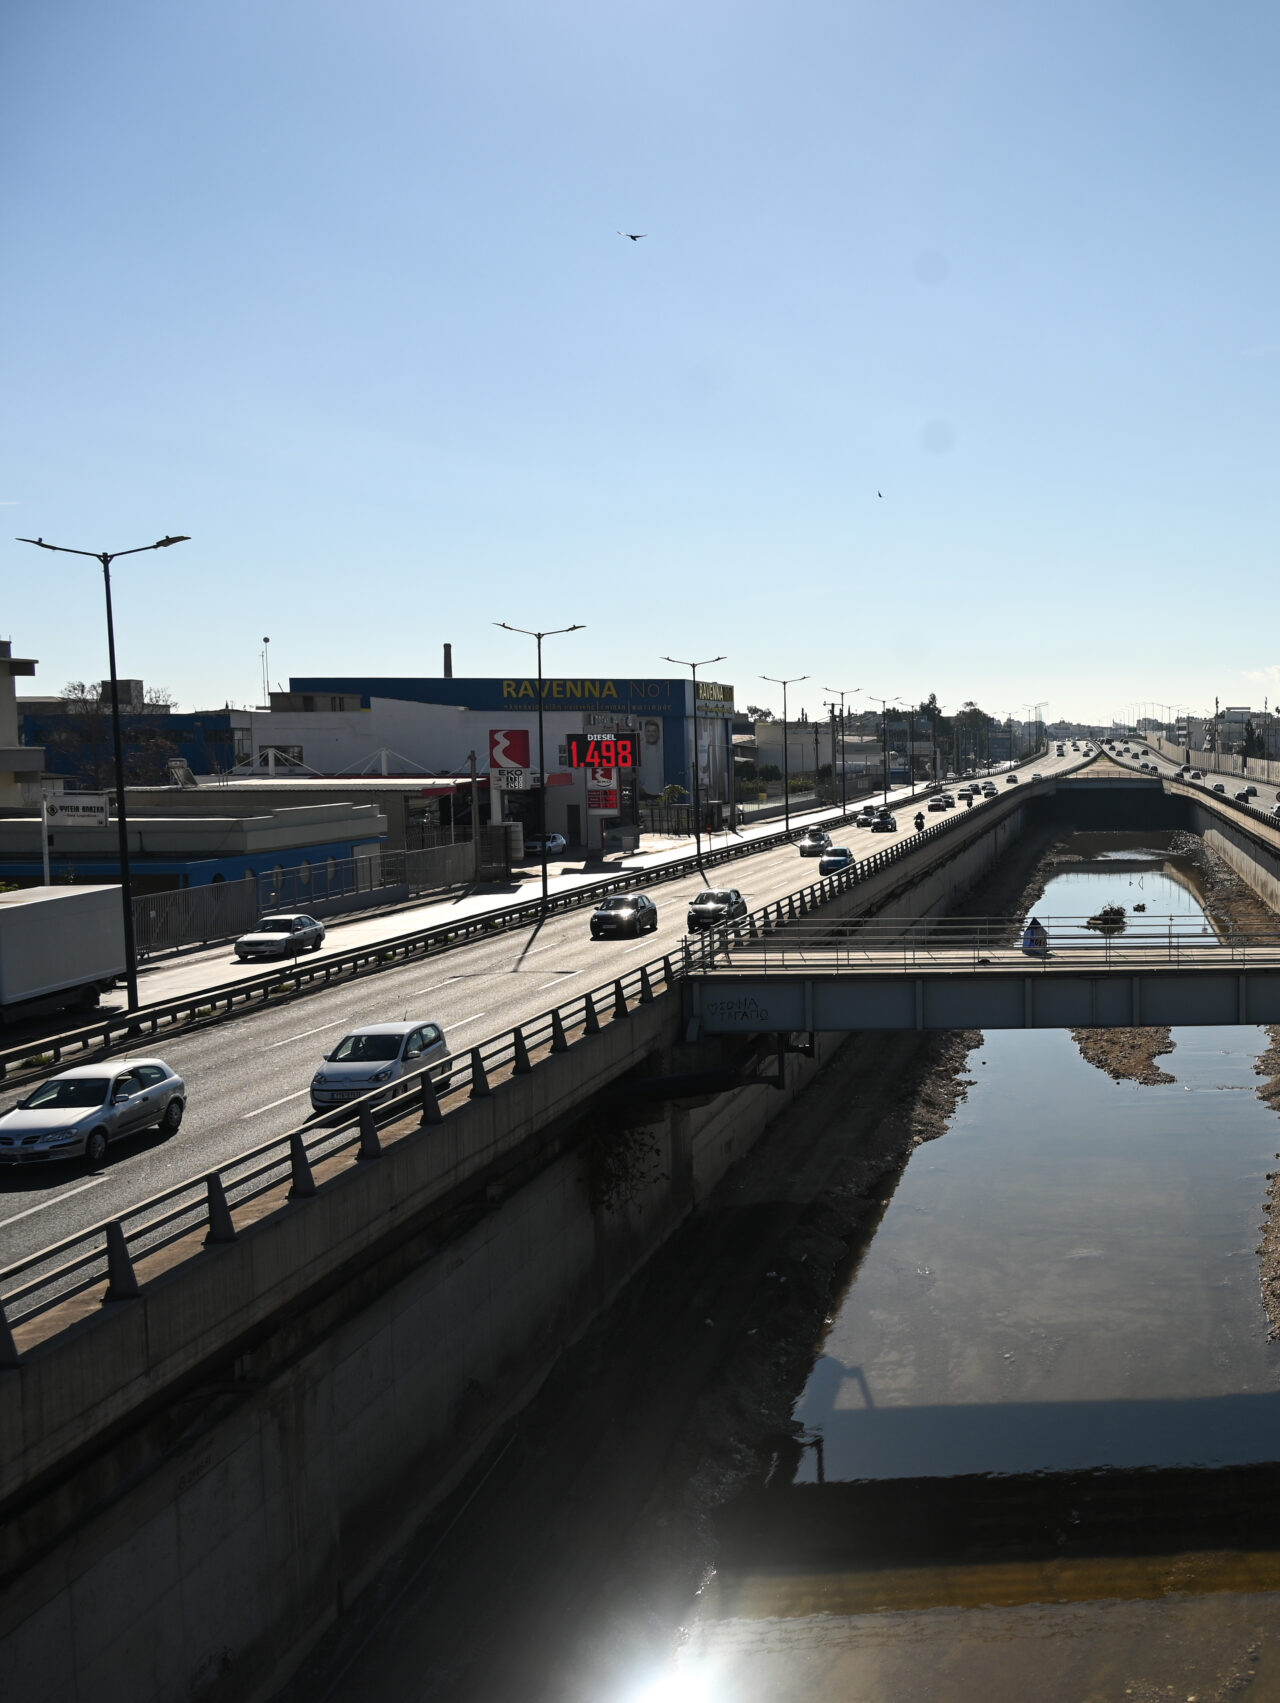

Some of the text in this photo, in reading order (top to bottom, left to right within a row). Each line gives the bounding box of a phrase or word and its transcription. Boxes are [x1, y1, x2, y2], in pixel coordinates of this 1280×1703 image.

[503, 680, 618, 699] RAVENNA
[587, 733, 617, 741] DIESEL
[570, 739, 633, 768] 1.498
